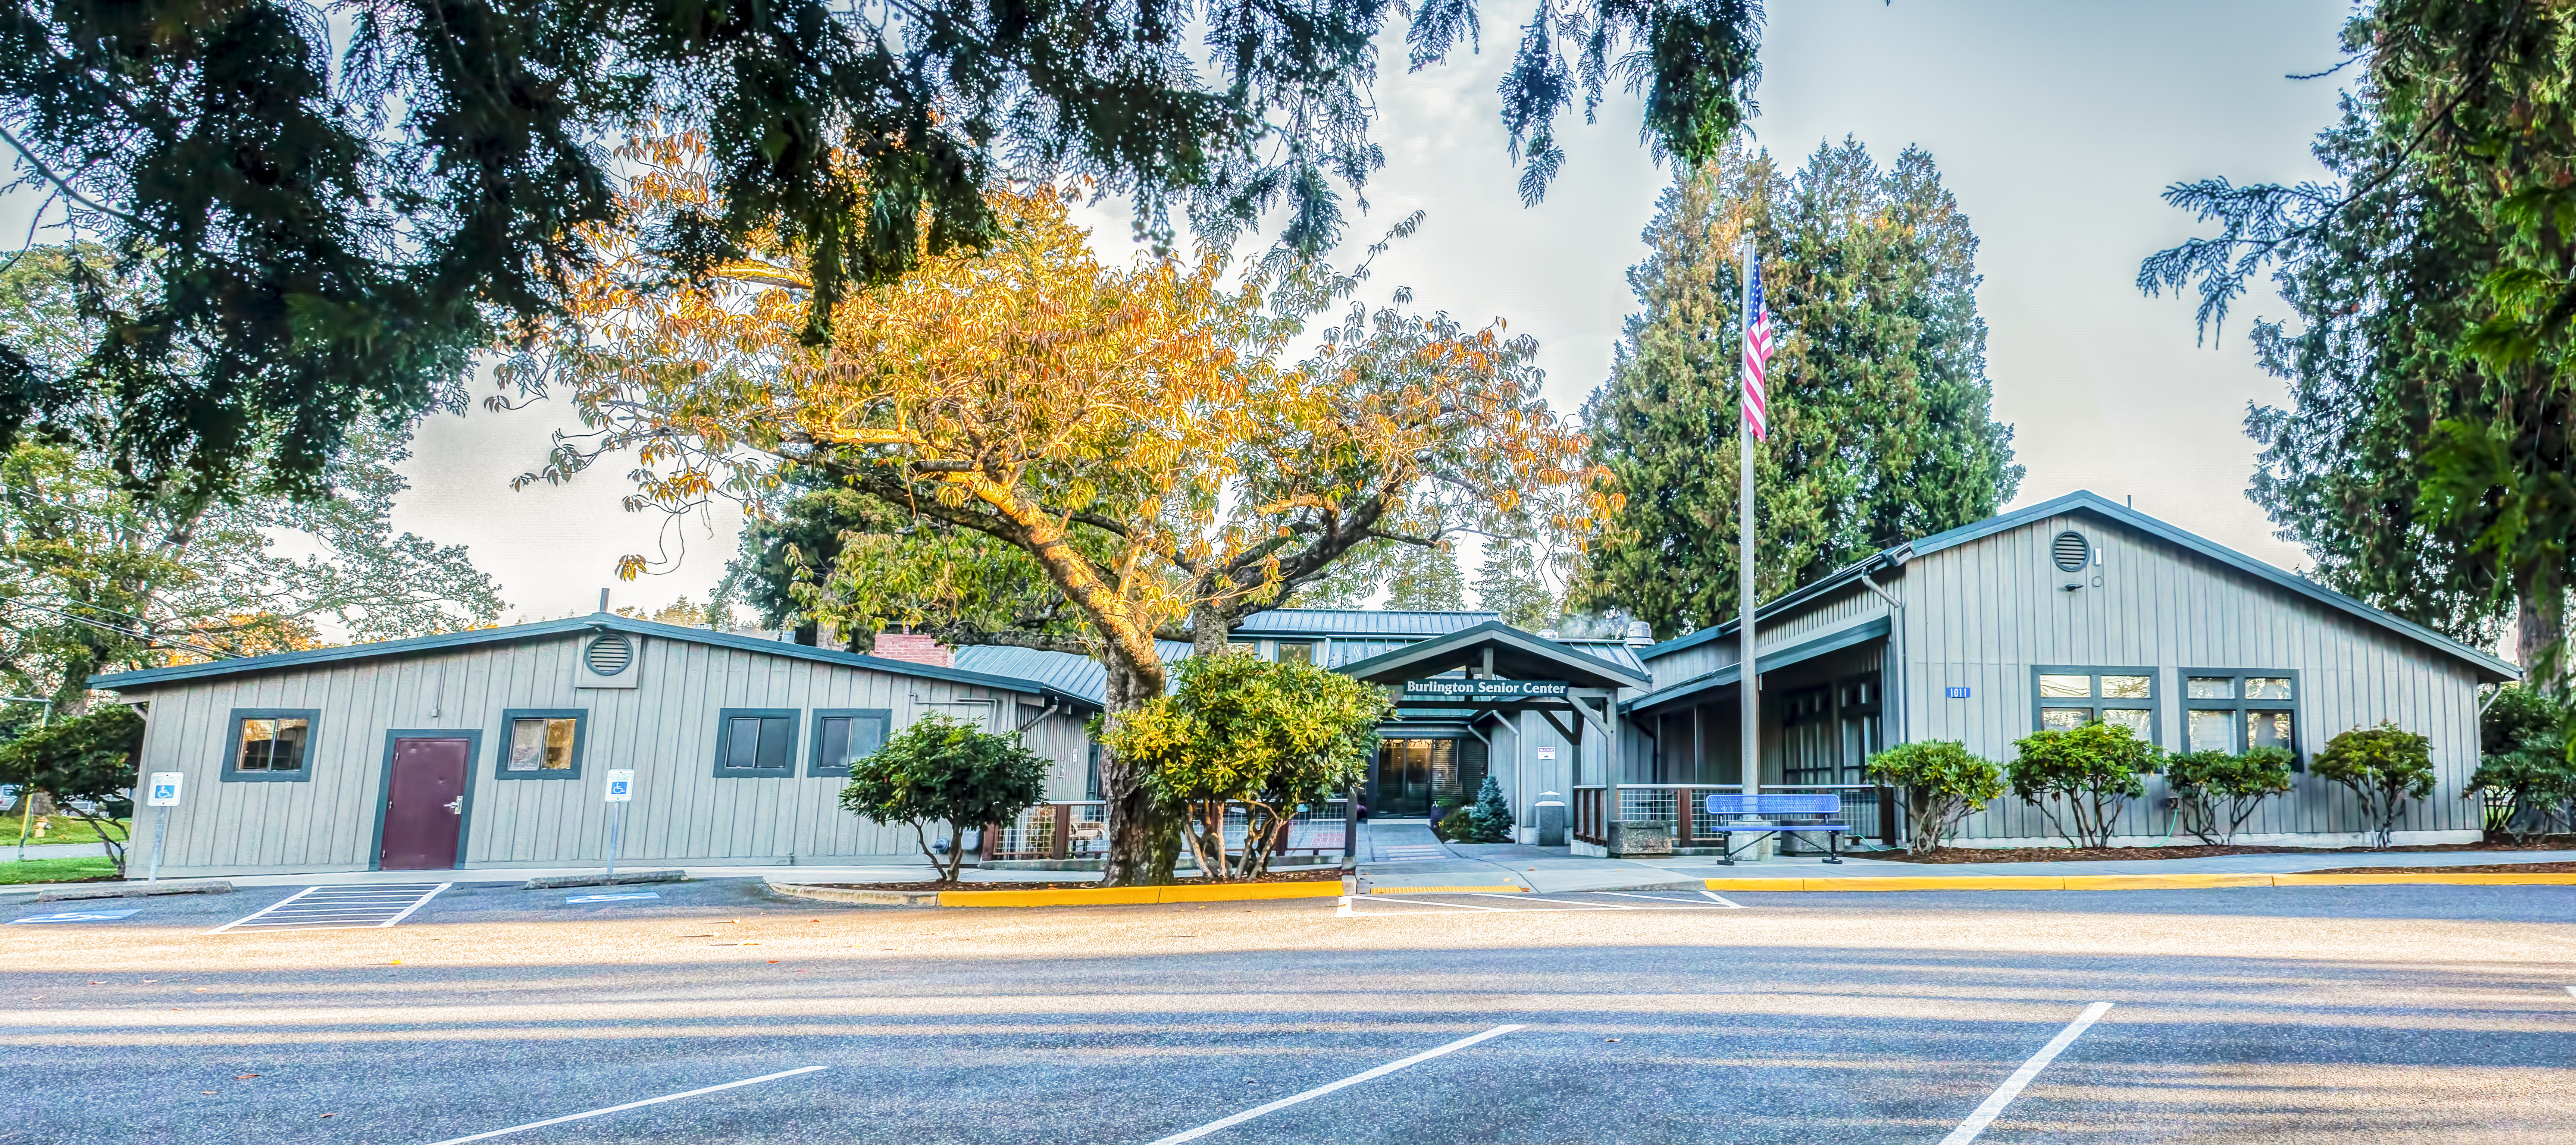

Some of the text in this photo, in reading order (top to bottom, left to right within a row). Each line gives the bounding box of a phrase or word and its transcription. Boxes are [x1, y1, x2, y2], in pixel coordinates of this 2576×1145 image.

[1407, 681, 1566, 695] Burlington Senior Center
[1950, 688, 1966, 697] 1011
